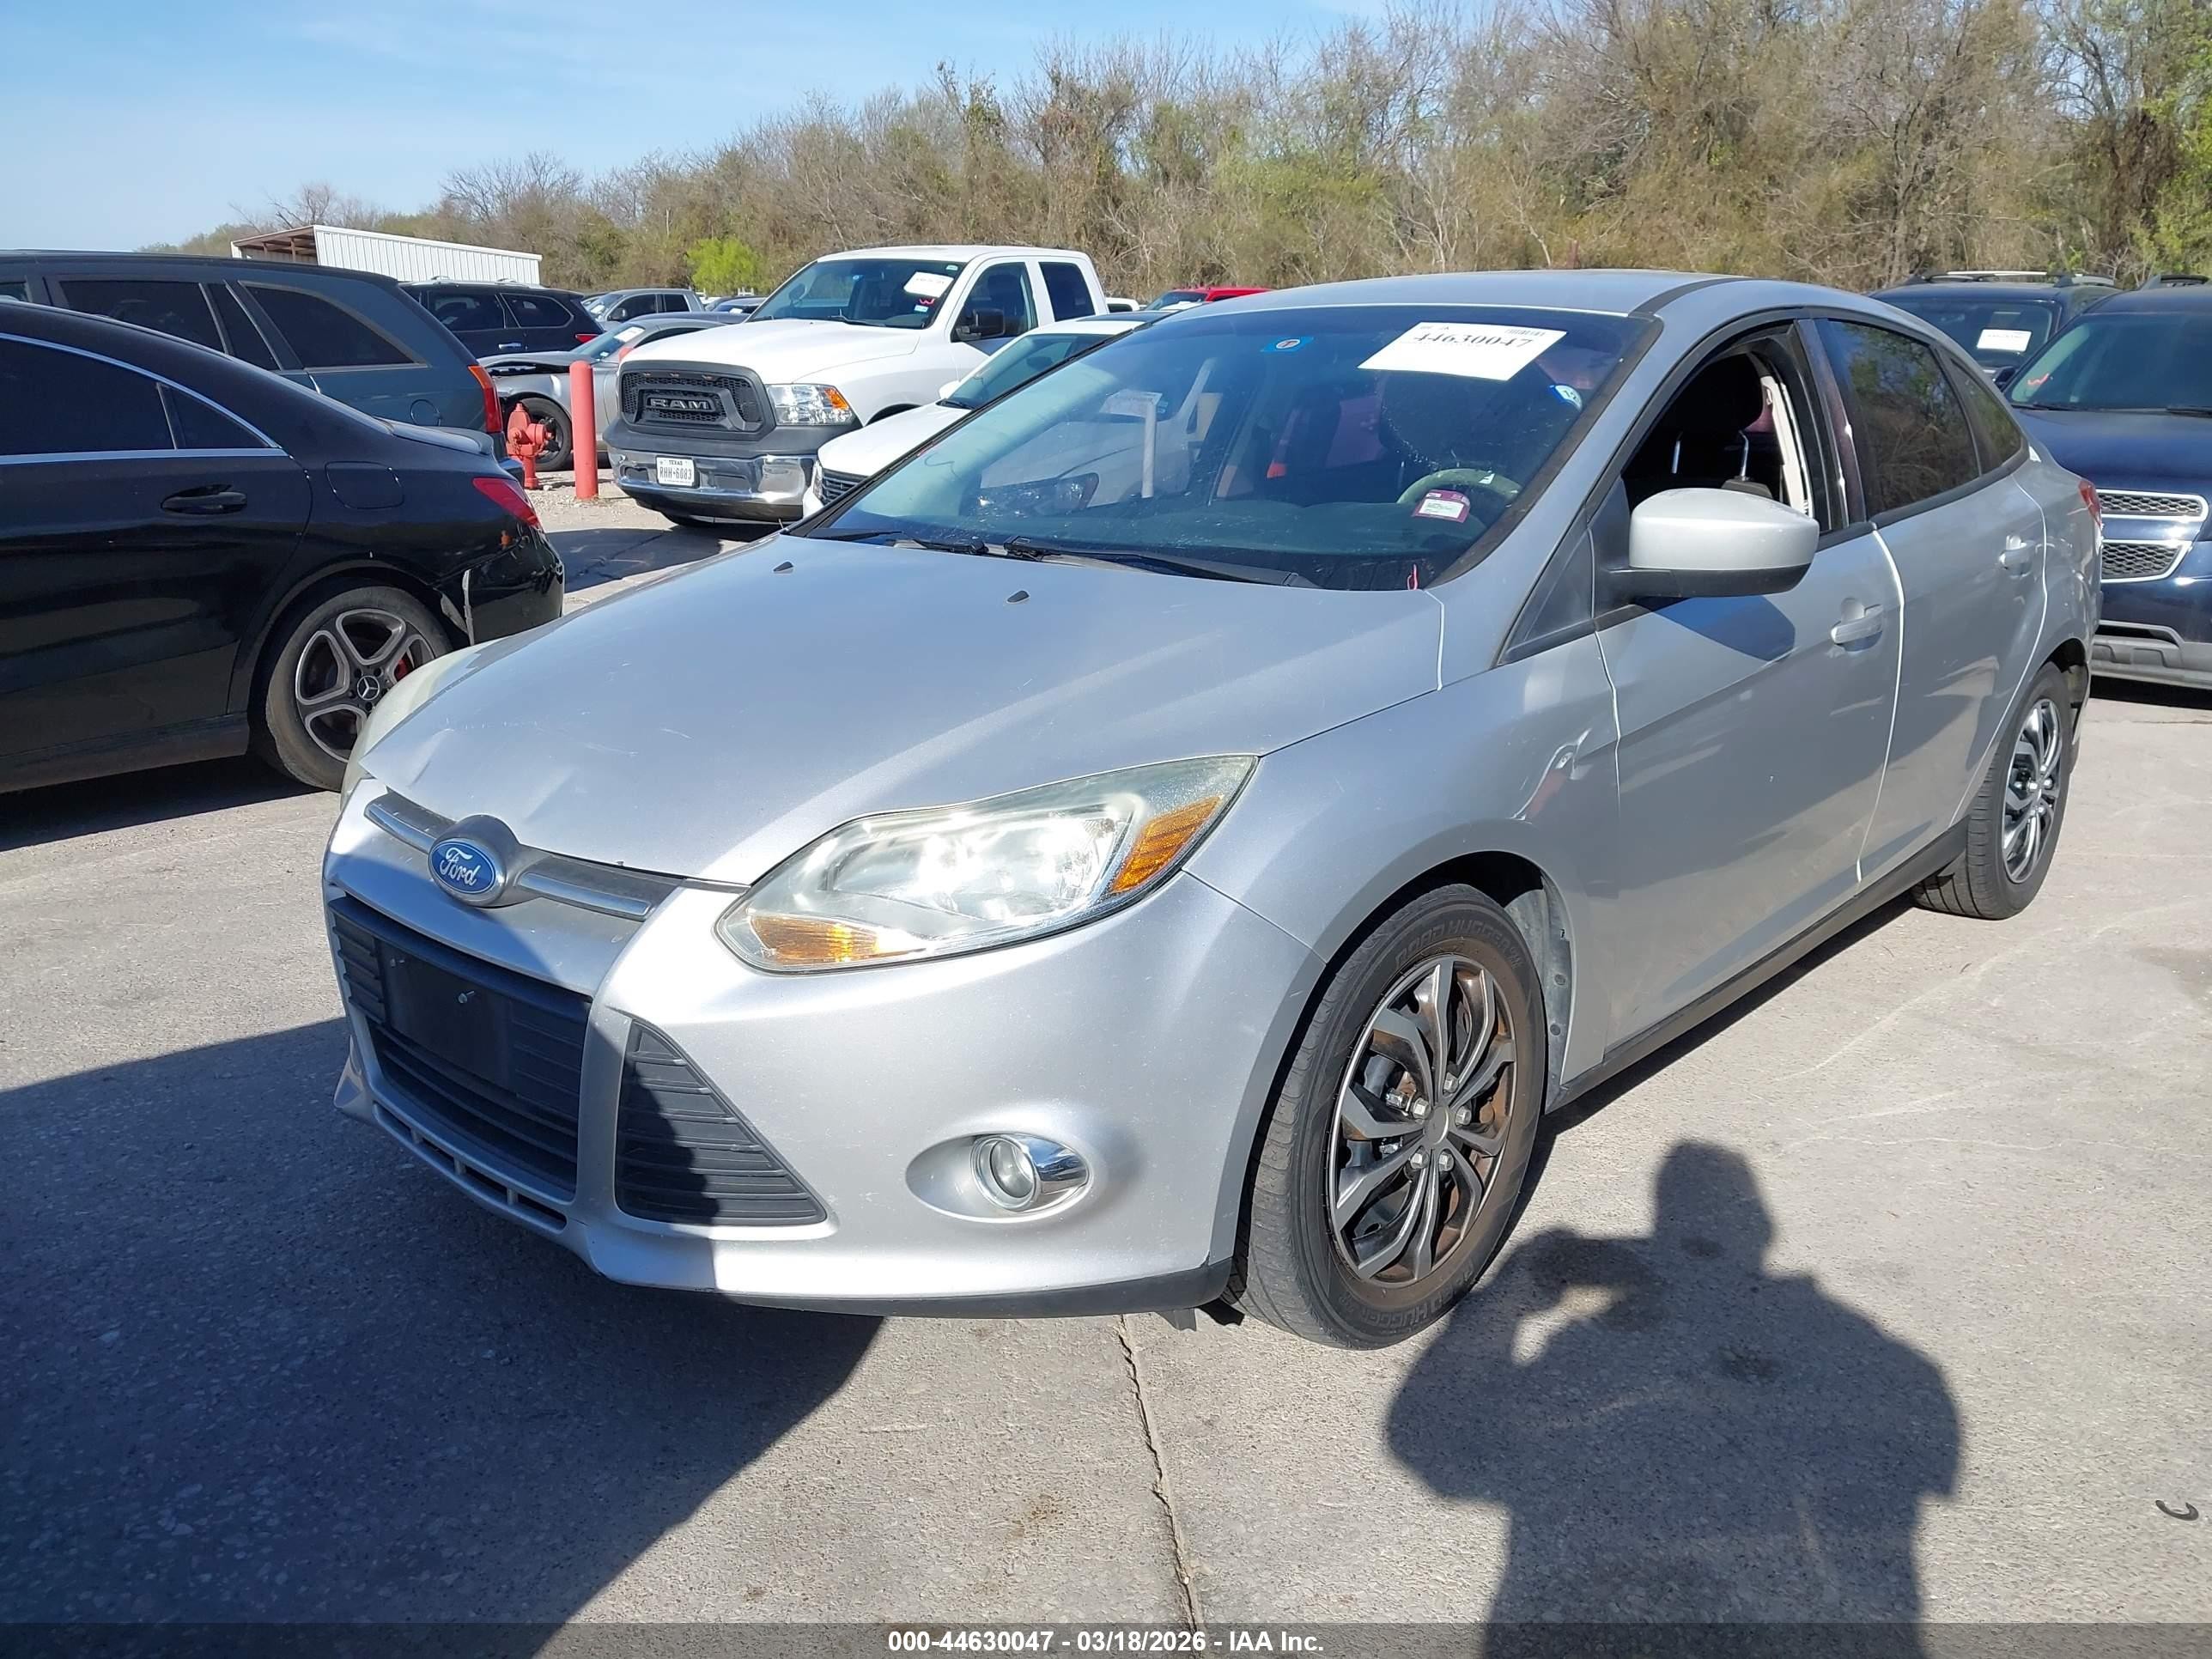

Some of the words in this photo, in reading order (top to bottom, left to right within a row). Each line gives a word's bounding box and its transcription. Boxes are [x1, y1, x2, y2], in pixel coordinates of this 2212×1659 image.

[1413, 332, 1534, 348] 44630047
[650, 398, 710, 410] RAM
[439, 847, 481, 886] Ford
